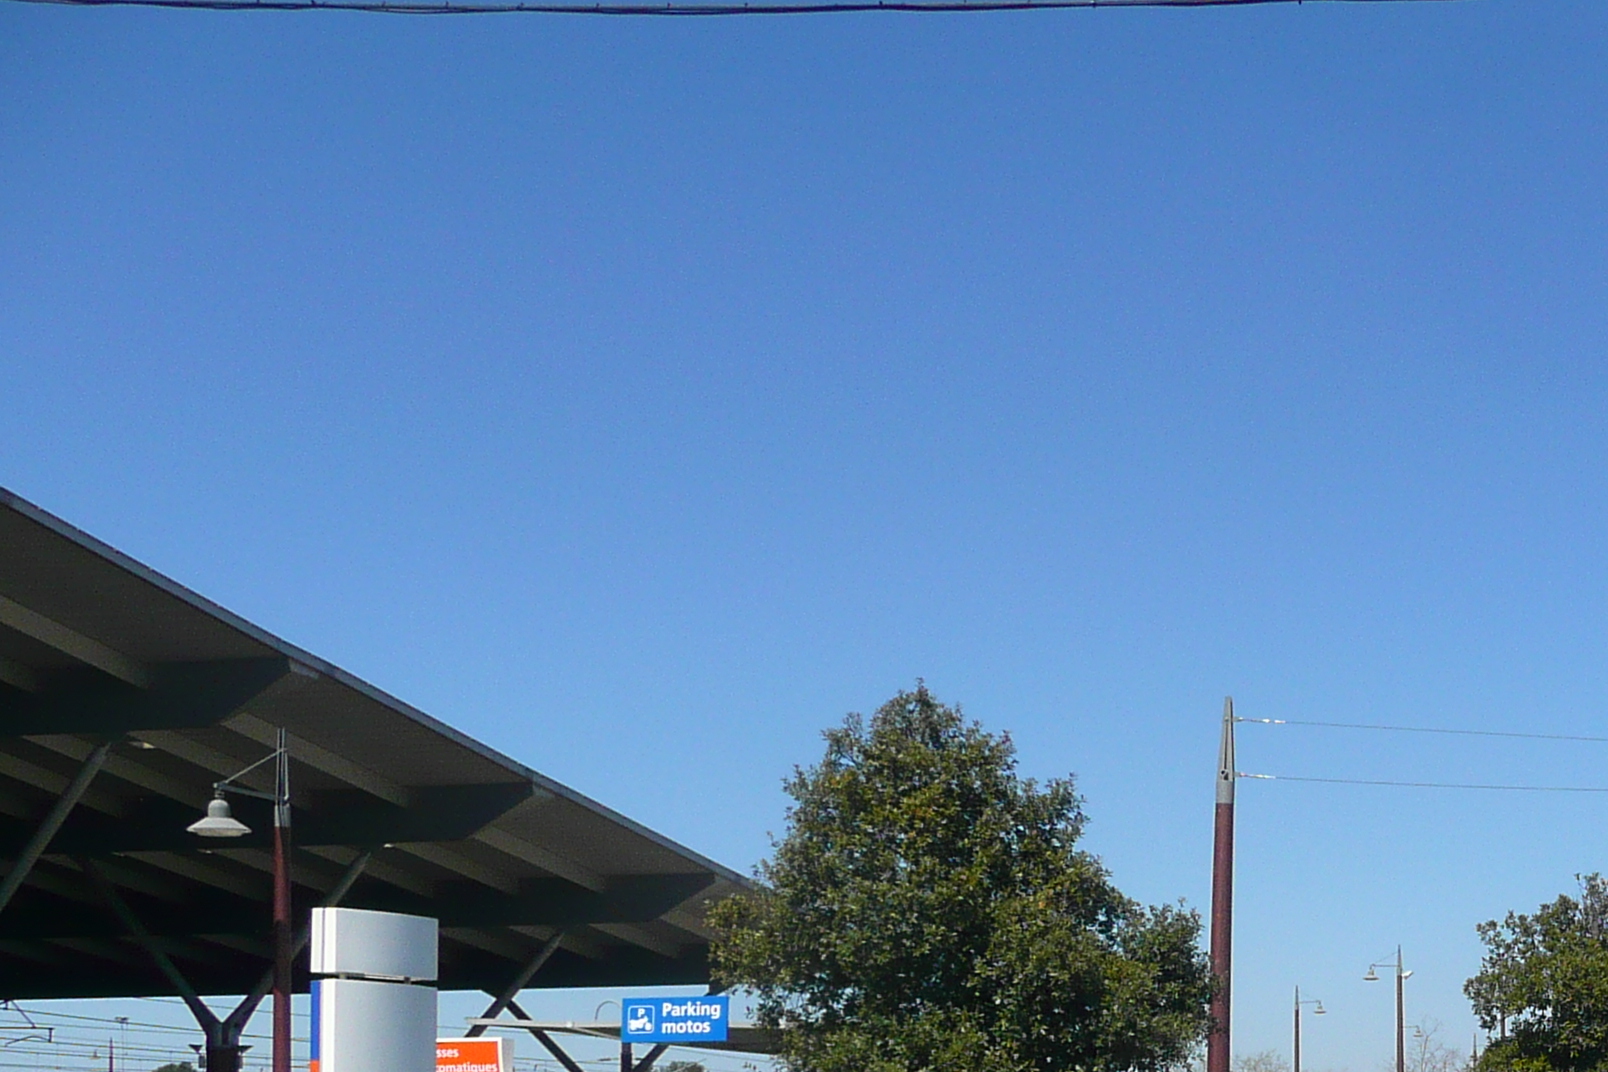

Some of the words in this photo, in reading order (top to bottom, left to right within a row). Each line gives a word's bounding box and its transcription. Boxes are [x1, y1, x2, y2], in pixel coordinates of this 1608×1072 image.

[662, 1001, 721, 1019] Parking
[662, 1020, 711, 1034] motos
[436, 1048, 460, 1058] sses
